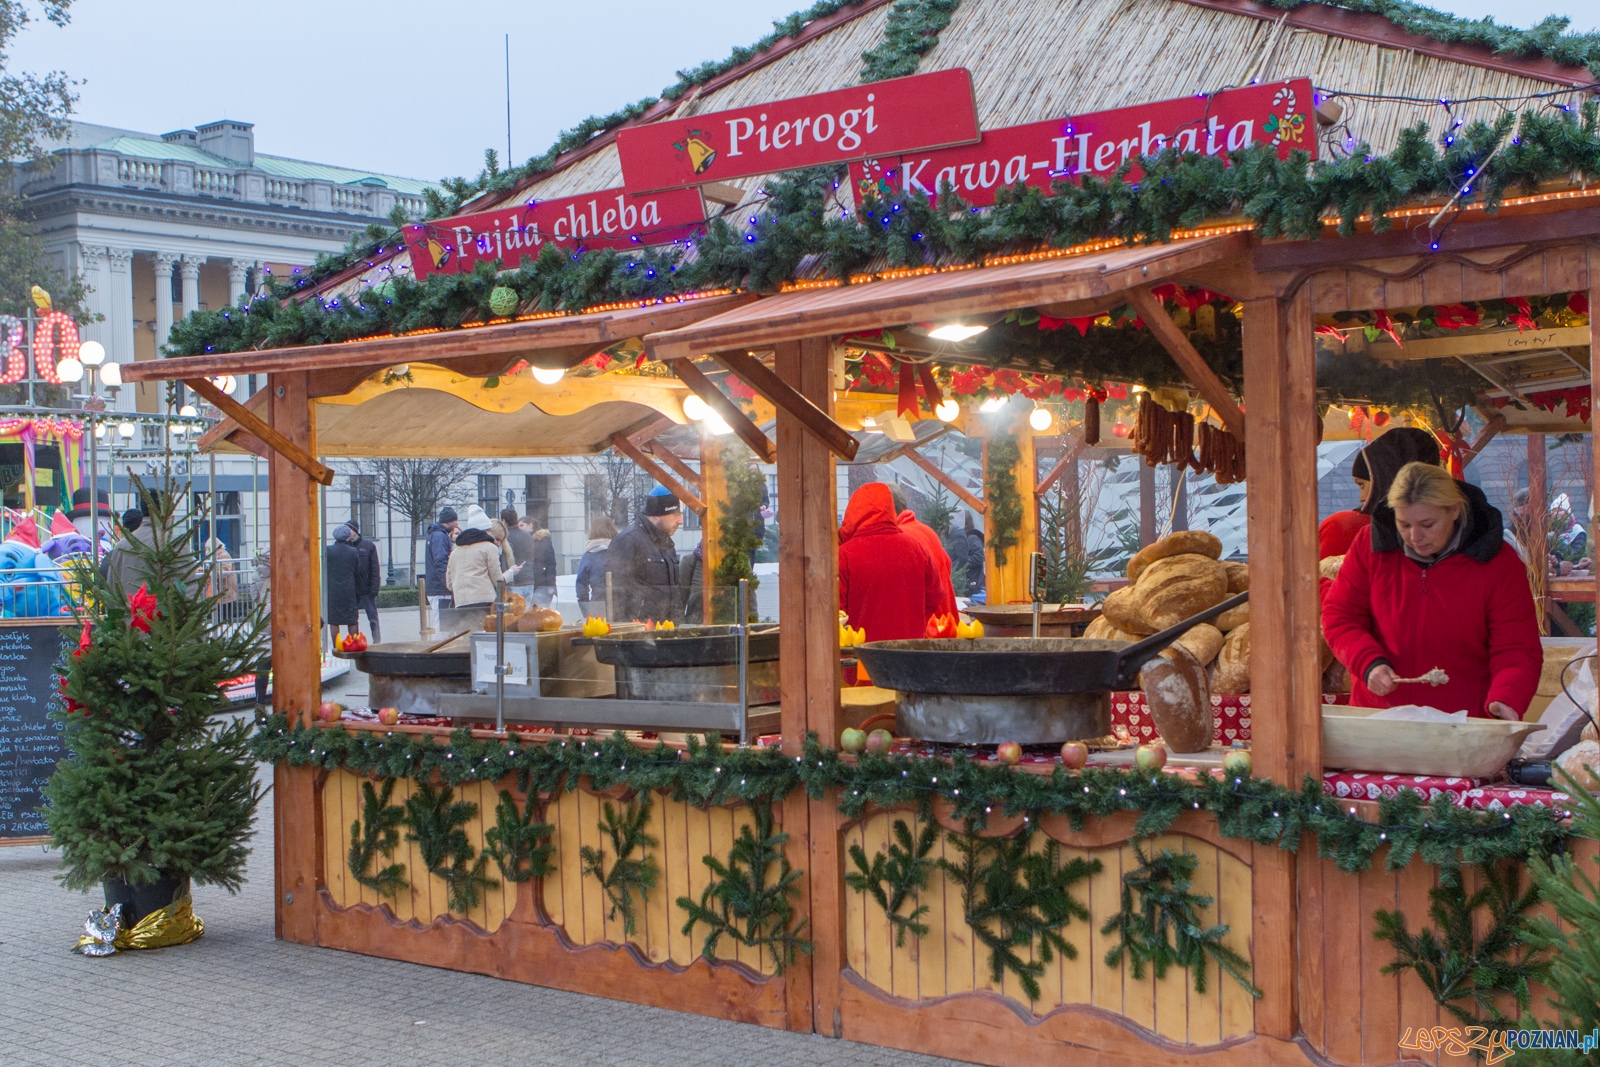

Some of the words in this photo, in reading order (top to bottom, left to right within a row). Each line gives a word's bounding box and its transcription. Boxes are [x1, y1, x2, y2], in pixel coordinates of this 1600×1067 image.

[725, 93, 878, 158] Pierogi
[901, 115, 1255, 198] Kawa-Herbata
[452, 214, 542, 259] Pajda
[553, 195, 661, 242] chleba
